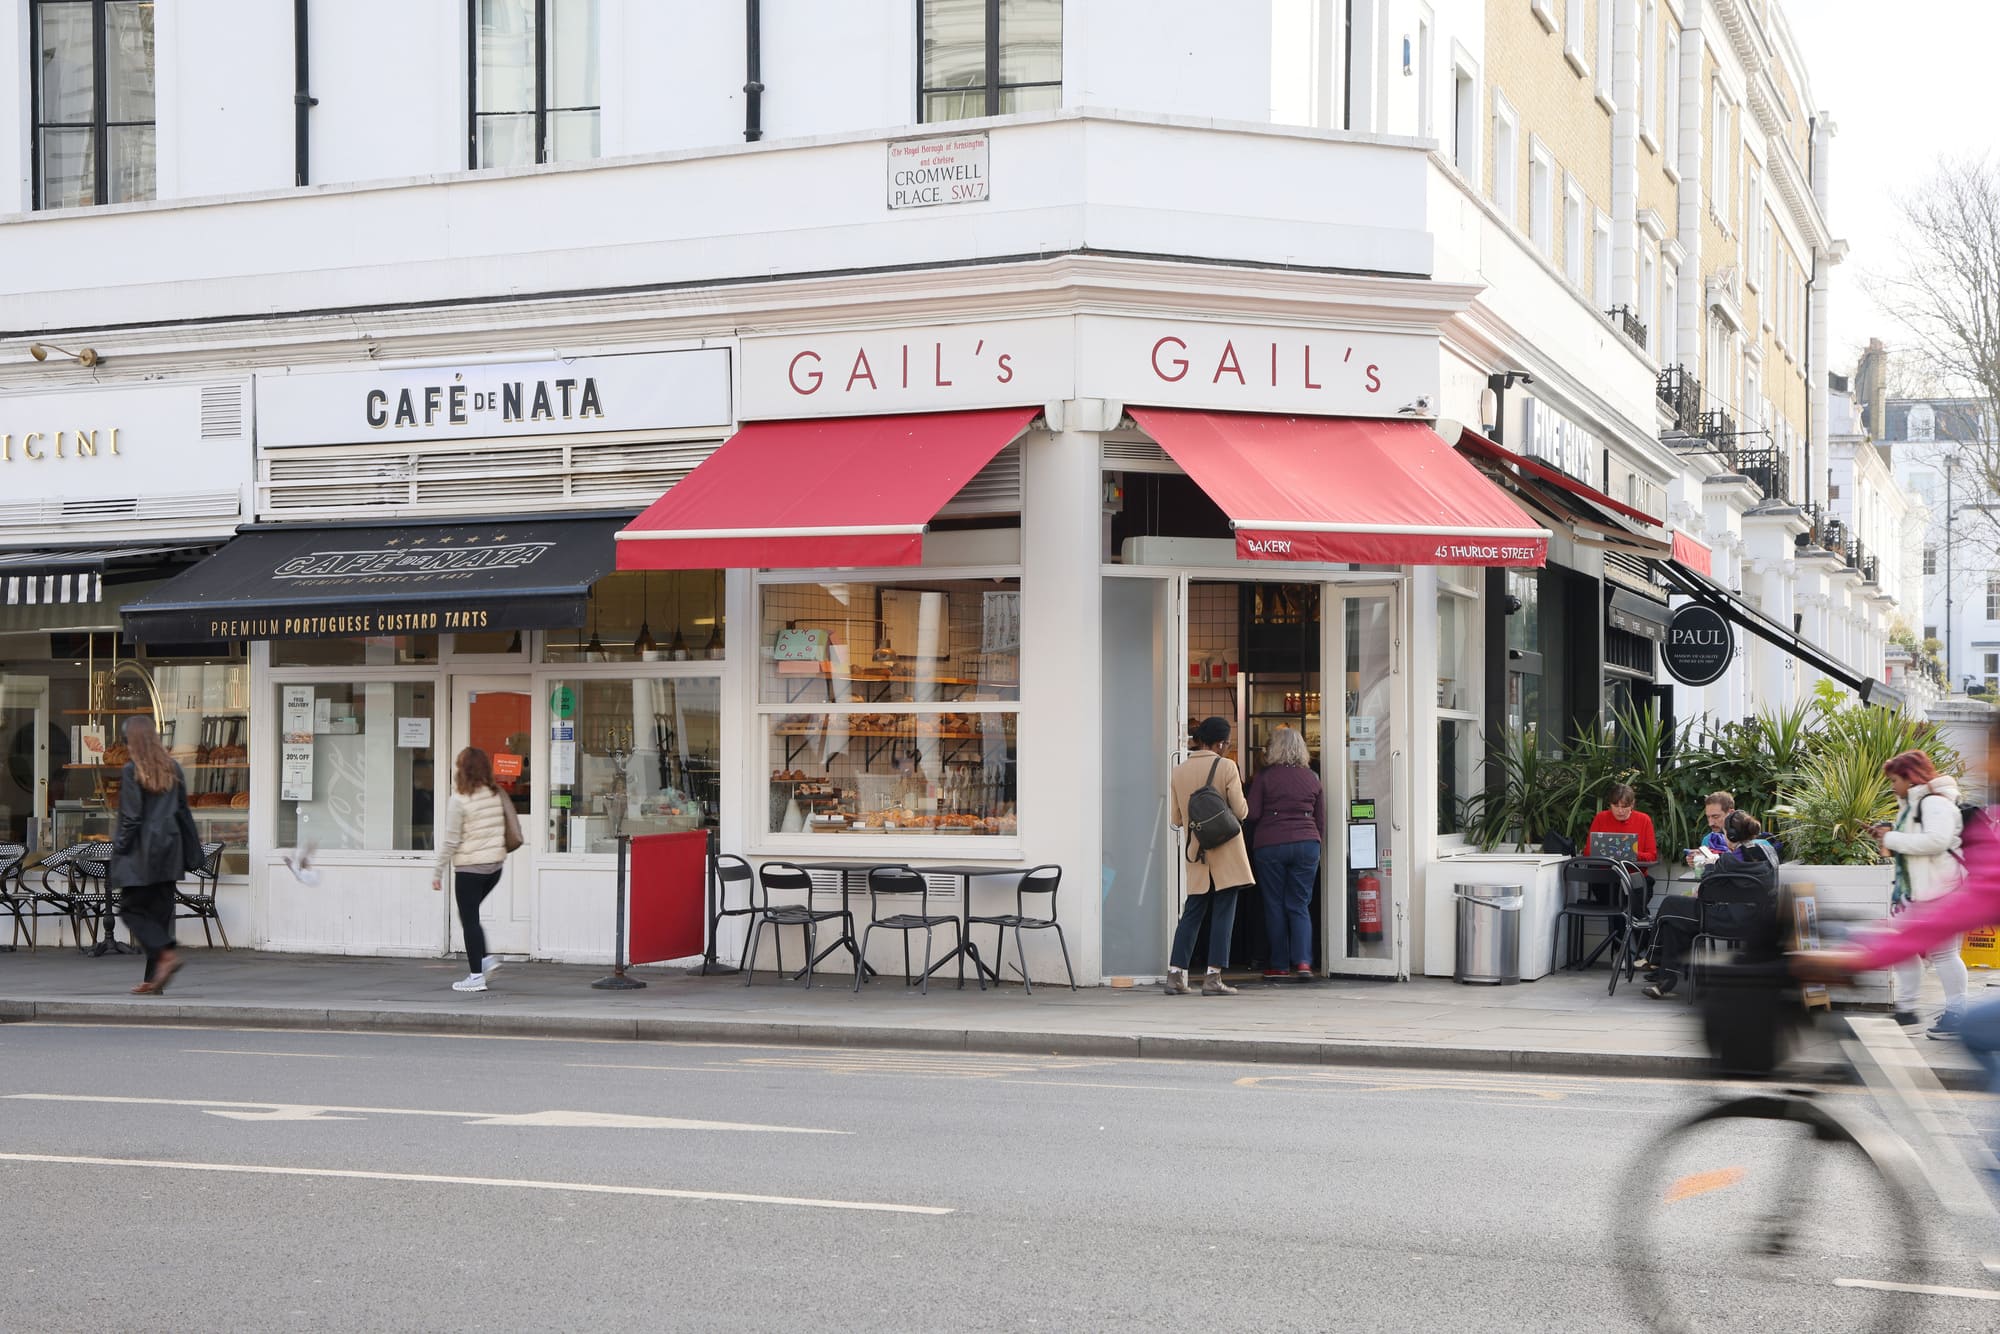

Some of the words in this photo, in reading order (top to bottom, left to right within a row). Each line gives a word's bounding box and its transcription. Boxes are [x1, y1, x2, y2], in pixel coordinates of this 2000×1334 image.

[891, 147, 902, 157] The
[904, 145, 919, 157] Royal
[921, 142, 944, 154] Borough
[953, 139, 985, 151] Kensington
[920, 158, 931, 167] and
[932, 156, 954, 166] Chelsea
[895, 164, 981, 186] CROMWELL
[951, 183, 984, 200] S.W.7
[788, 339, 1014, 396] GAIL's
[1151, 336, 1382, 394] GAIL's
[366, 373, 468, 429] CAFÉ
[474, 391, 497, 411] DE
[502, 377, 604, 422] NATA
[1, 428, 119, 461] ICINI
[1248, 540, 1291, 553] BAKERY
[1434, 545, 1448, 558] 45
[1450, 545, 1499, 559] THURLOE
[1501, 547, 1535, 560] STREET
[420, 546, 548, 570] NATA
[211, 620, 279, 637] PREMIUM
[284, 615, 370, 634] PORTUGUESE
[378, 612, 437, 631] CUSTARD
[445, 611, 488, 628] TARTS
[1671, 629, 1725, 645] PAUL
